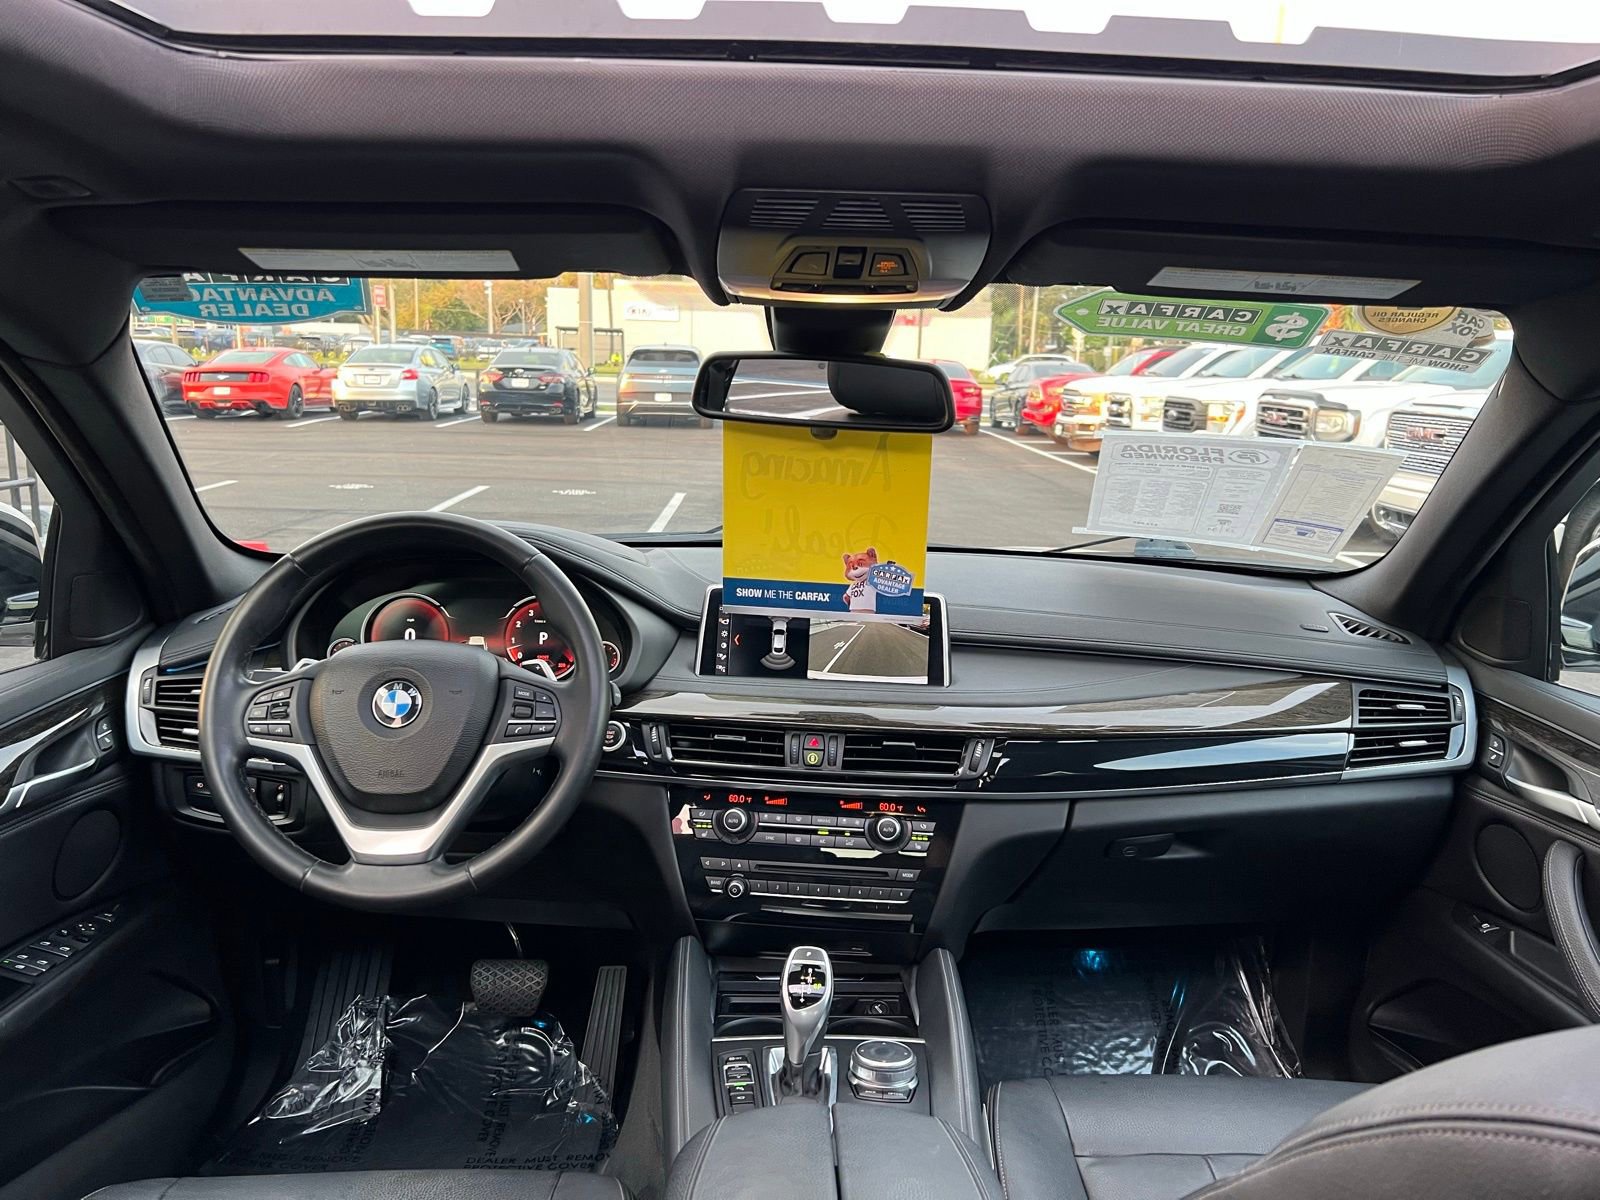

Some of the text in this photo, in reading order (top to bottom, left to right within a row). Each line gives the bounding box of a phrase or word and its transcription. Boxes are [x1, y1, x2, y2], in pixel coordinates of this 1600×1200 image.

[873, 570, 910, 585] CARFAX
[873, 577, 905, 590] ADVANTAGE
[877, 584, 899, 594] DEALER
[736, 587, 830, 602] SHOW ME THE CARFAX
[515, 620, 521, 628] 2
[538, 631, 549, 645] P
[728, 794, 745, 803] 60.0
[879, 802, 896, 811] 60.0
[466, 1155, 517, 1165] DEALER
[525, 1153, 558, 1165] MUST
[547, 1161, 596, 1171] COVER
